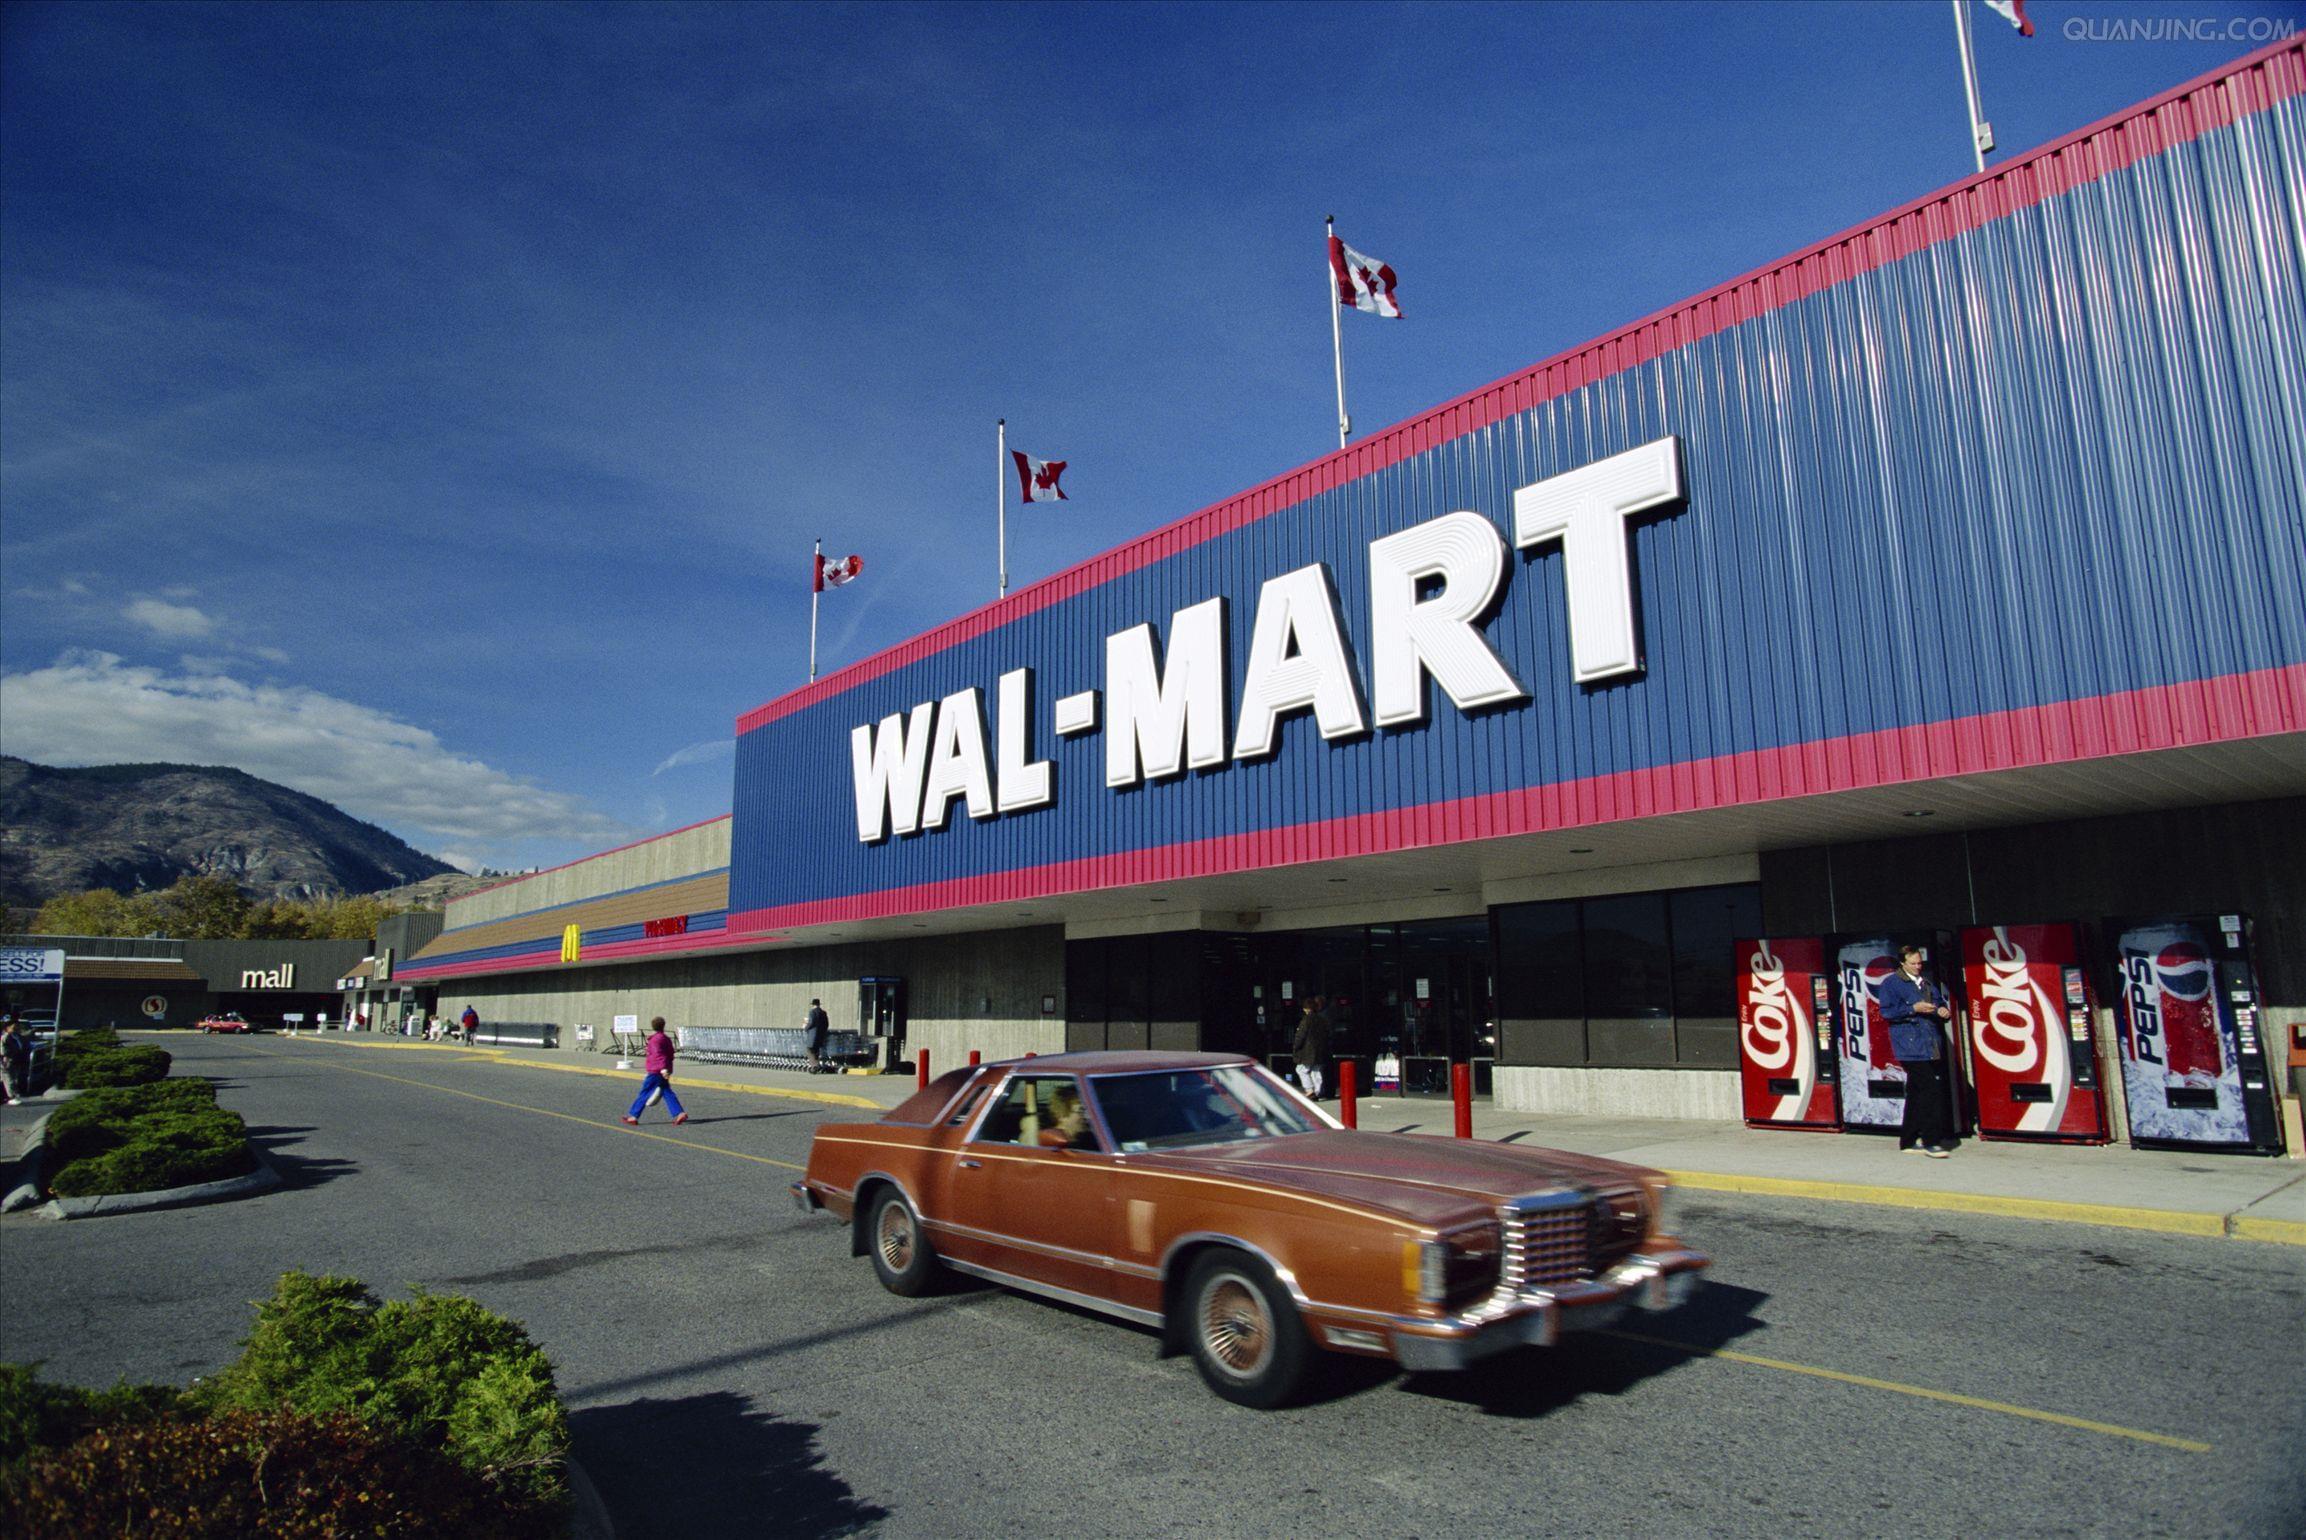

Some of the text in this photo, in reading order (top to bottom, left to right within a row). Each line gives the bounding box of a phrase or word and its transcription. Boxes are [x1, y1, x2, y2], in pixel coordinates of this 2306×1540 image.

[850, 433, 1684, 842] WAL-MART
[241, 963, 294, 989] mall
[1741, 939, 1790, 1070] Coke
[1842, 960, 1867, 1062] PEPSI
[1972, 926, 2039, 1073] Coke
[2125, 947, 2163, 1066] PEPSI
